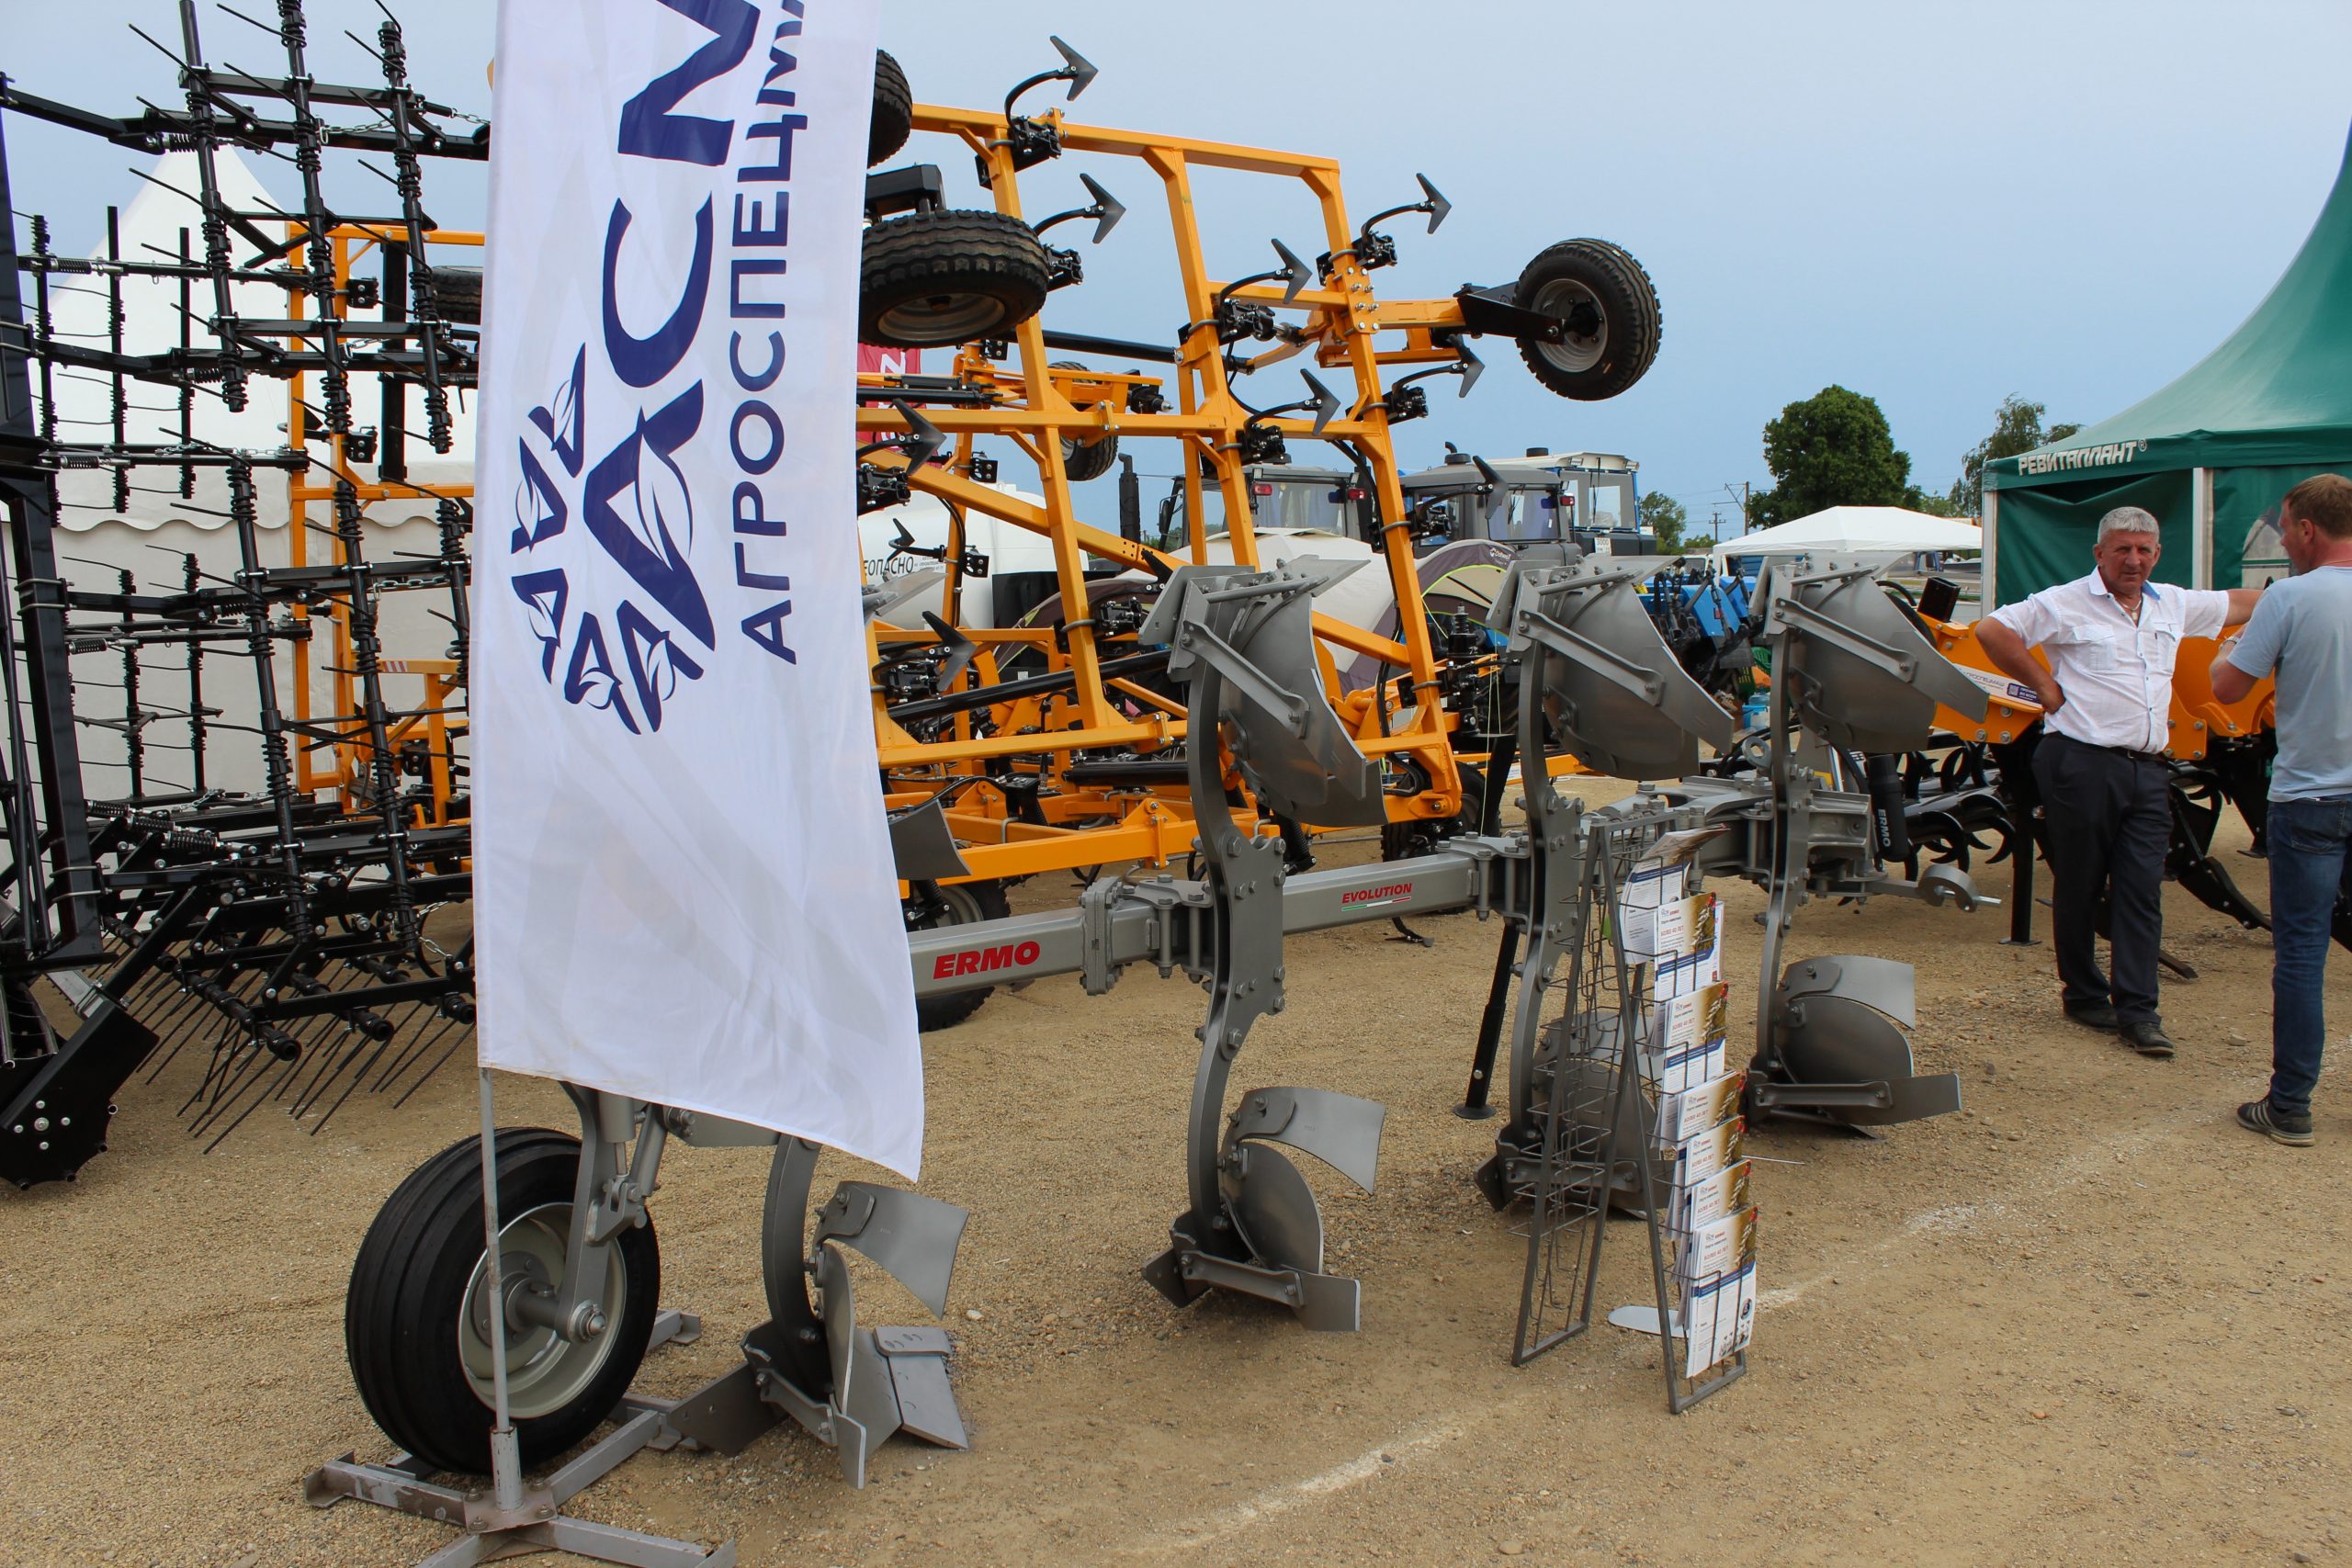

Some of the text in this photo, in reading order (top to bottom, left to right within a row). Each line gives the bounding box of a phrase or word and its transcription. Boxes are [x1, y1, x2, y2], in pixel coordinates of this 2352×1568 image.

[2018, 440, 2137, 476] РЕВИТАПЛАНТ
[1878, 808, 1892, 847] ERMO
[1341, 883, 1412, 904] EVOLUTION
[933, 941, 1040, 979] ERMO
